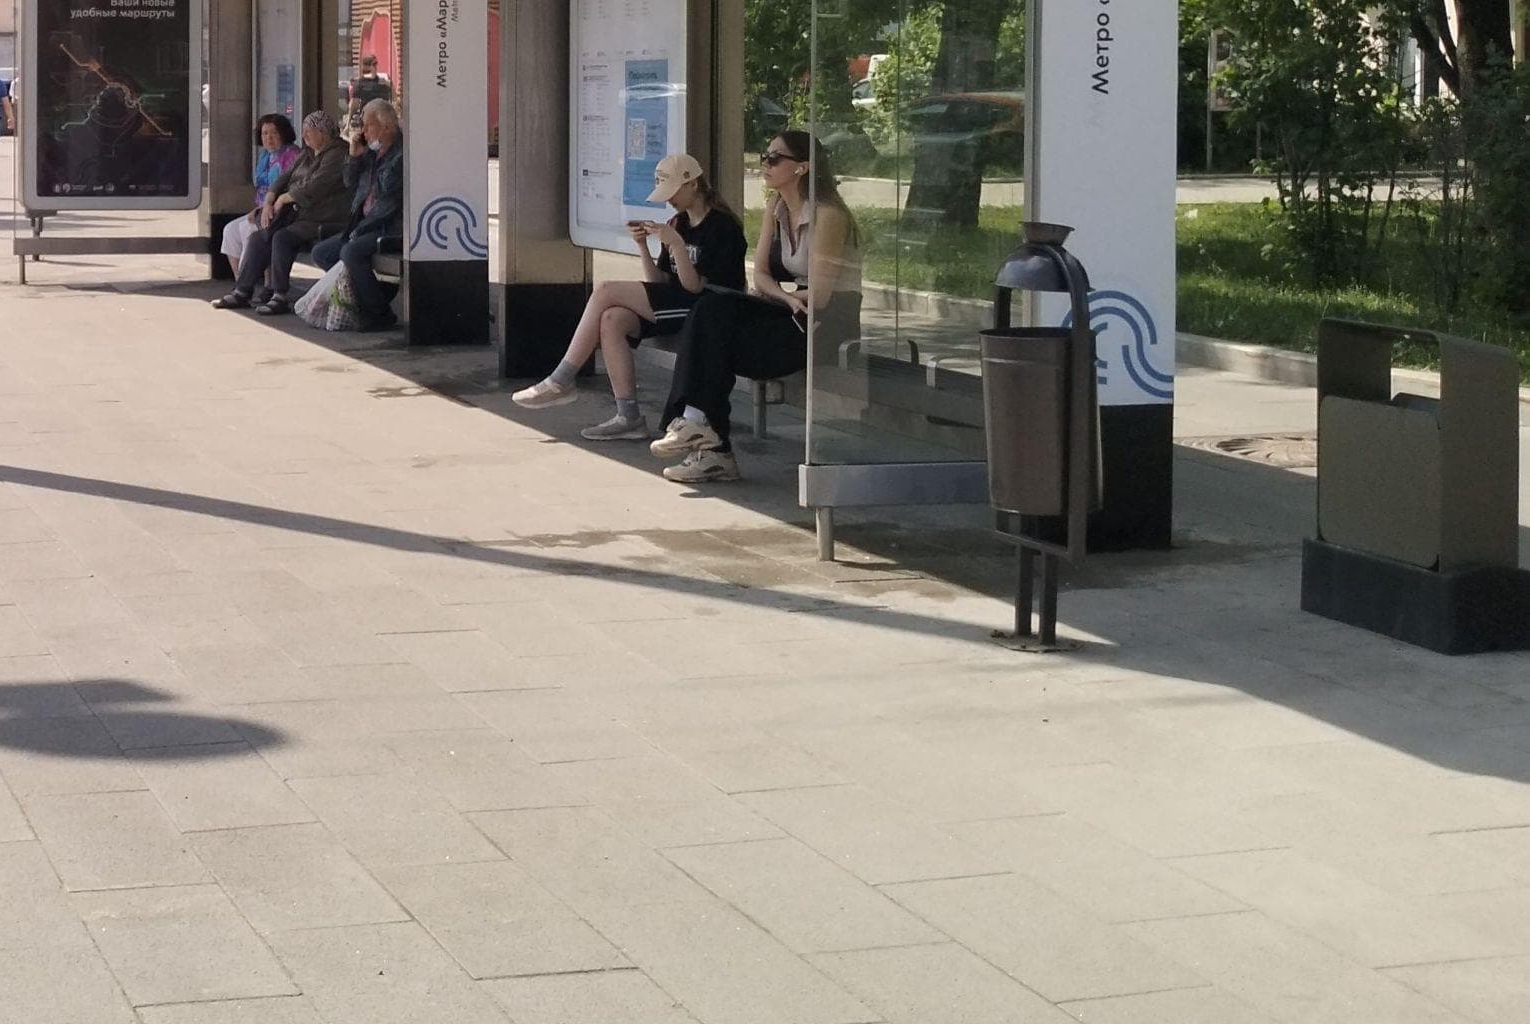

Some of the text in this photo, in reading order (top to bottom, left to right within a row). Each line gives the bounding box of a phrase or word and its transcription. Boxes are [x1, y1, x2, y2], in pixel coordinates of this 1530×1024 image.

[70, 7, 175, 19] удобные маршруты
[142, 0, 175, 7] новые
[436, 41, 449, 88] Метро
[1091, 11, 1115, 96] Метро
